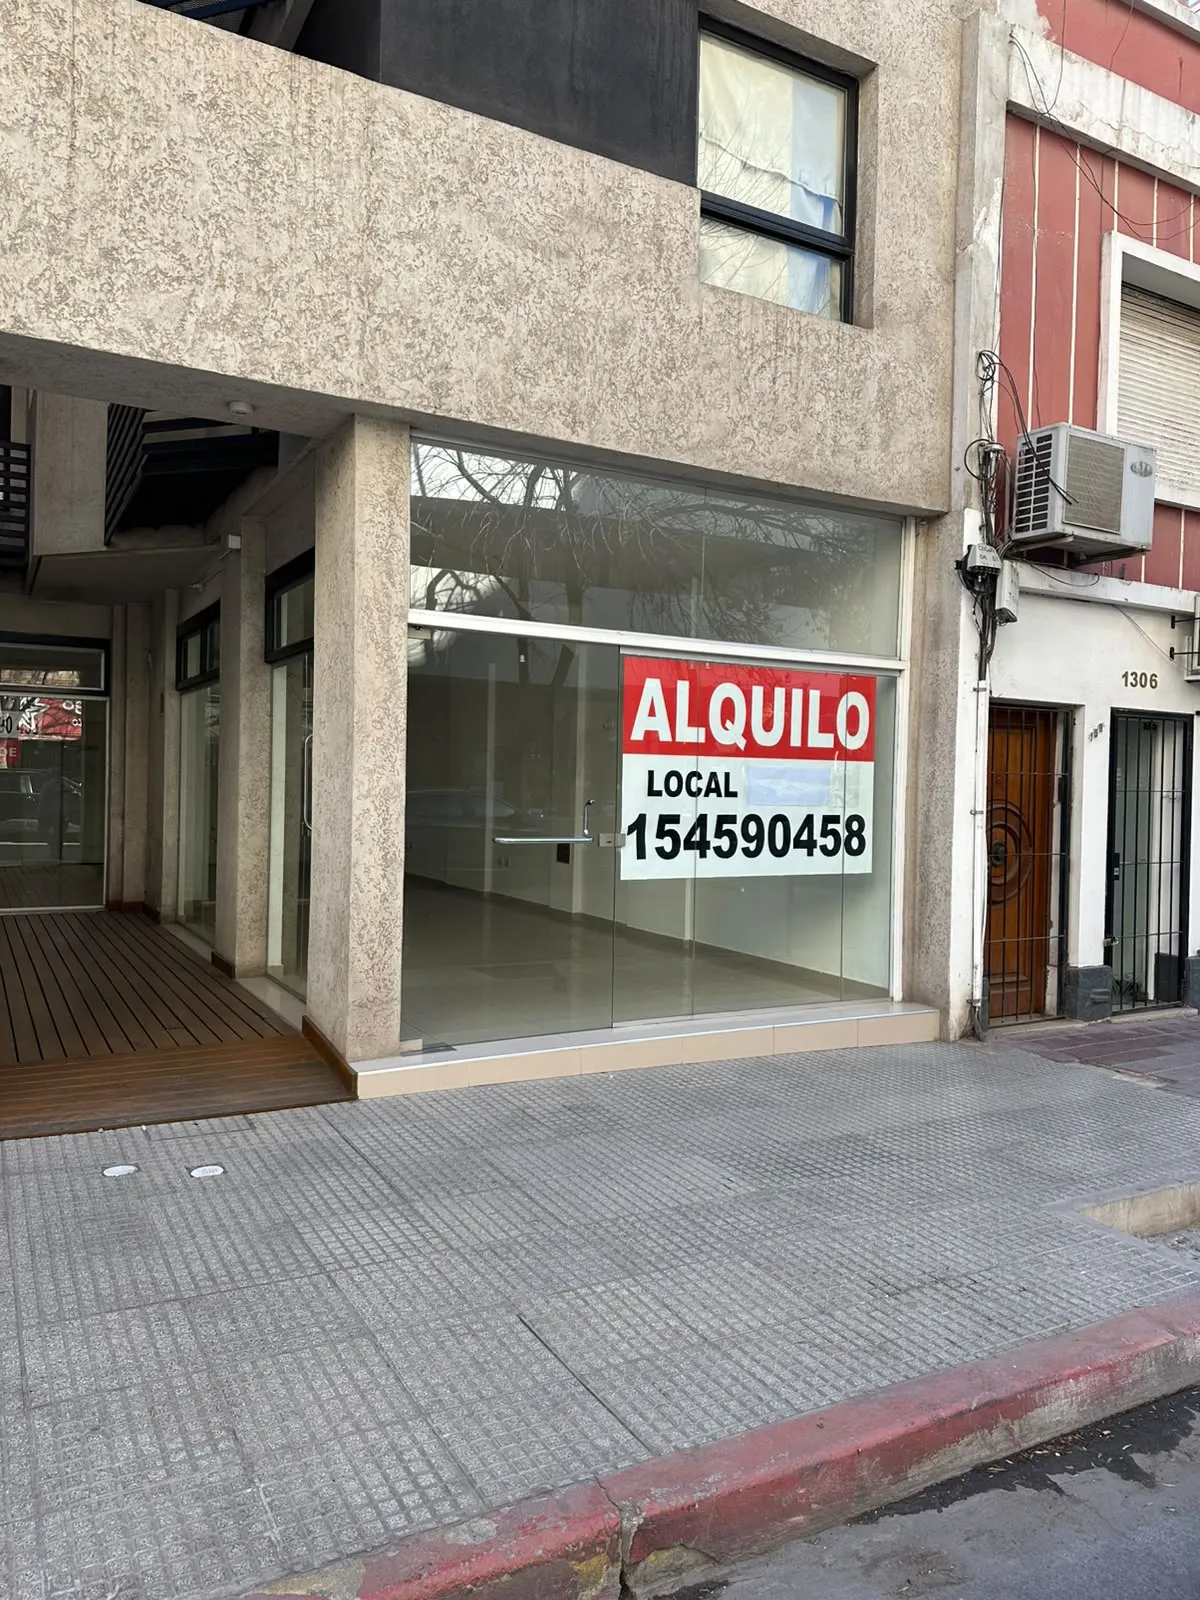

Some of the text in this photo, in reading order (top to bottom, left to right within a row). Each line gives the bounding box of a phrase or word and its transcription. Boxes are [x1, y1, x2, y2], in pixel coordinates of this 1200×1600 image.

[1121, 671, 1158, 689] 1306
[630, 677, 870, 751] ALQUILO
[647, 769, 738, 798] LOCAL
[626, 813, 867, 860] 154590458
